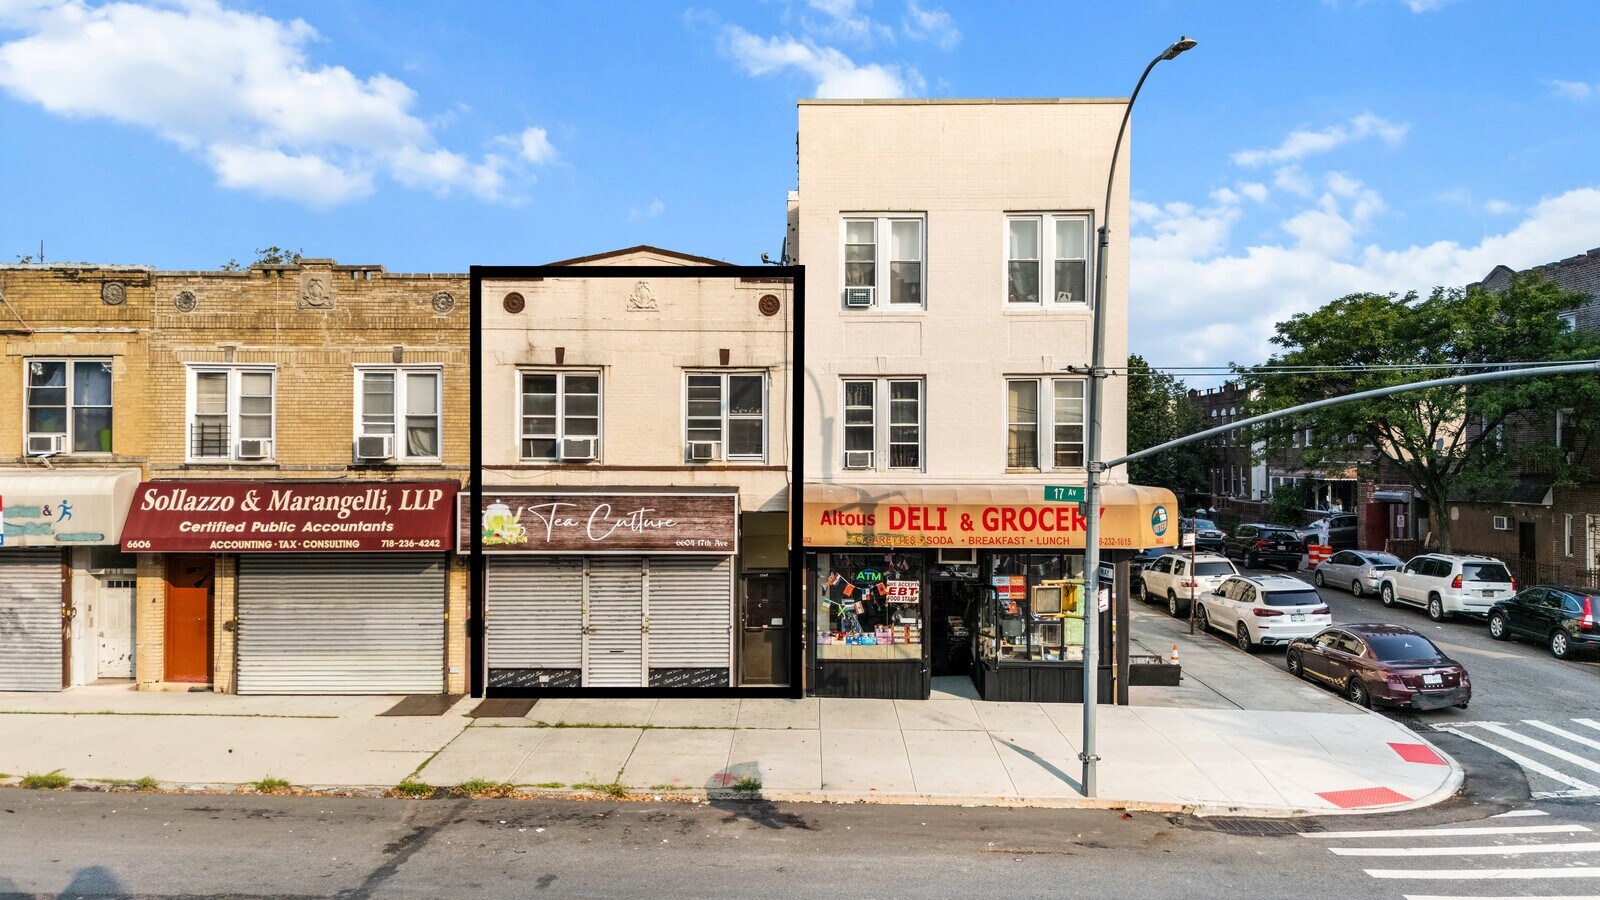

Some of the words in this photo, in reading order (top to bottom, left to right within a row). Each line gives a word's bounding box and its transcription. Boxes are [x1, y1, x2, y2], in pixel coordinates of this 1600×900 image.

[1054, 488, 1064, 500] 17
[1068, 488, 1077, 497] Av
[141, 488, 235, 511] Sollazzo
[240, 490, 262, 511] &
[267, 489, 392, 519] Marangelli,
[398, 489, 443, 511] LLP
[43, 504, 52, 516] &
[528, 502, 579, 542] Tea
[587, 503, 678, 541] Culture
[820, 510, 876, 526] Altous
[889, 507, 947, 531] DELI
[960, 513, 975, 532] &
[982, 506, 1105, 532] GROCER
[180, 521, 246, 532] Certified
[251, 521, 296, 532] Public
[302, 521, 394, 532] Accountants
[127, 540, 151, 548] 6606
[210, 540, 273, 549] ACCOUNTING
[279, 540, 297, 548] TAX
[303, 540, 360, 548] CONSULTING
[381, 539, 440, 548] 718-236-4242
[676, 539, 695, 547] 6604
[698, 539, 712, 547] 17th
[714, 539, 728, 547] Ave
[926, 536, 953, 545] SODA
[968, 537, 1026, 545] BREAKFAST
[1037, 537, 1070, 545] LUNCH
[1099, 537, 1132, 546] 8-232-1615
[856, 571, 881, 581] ATM
[888, 587, 917, 596] EBT
